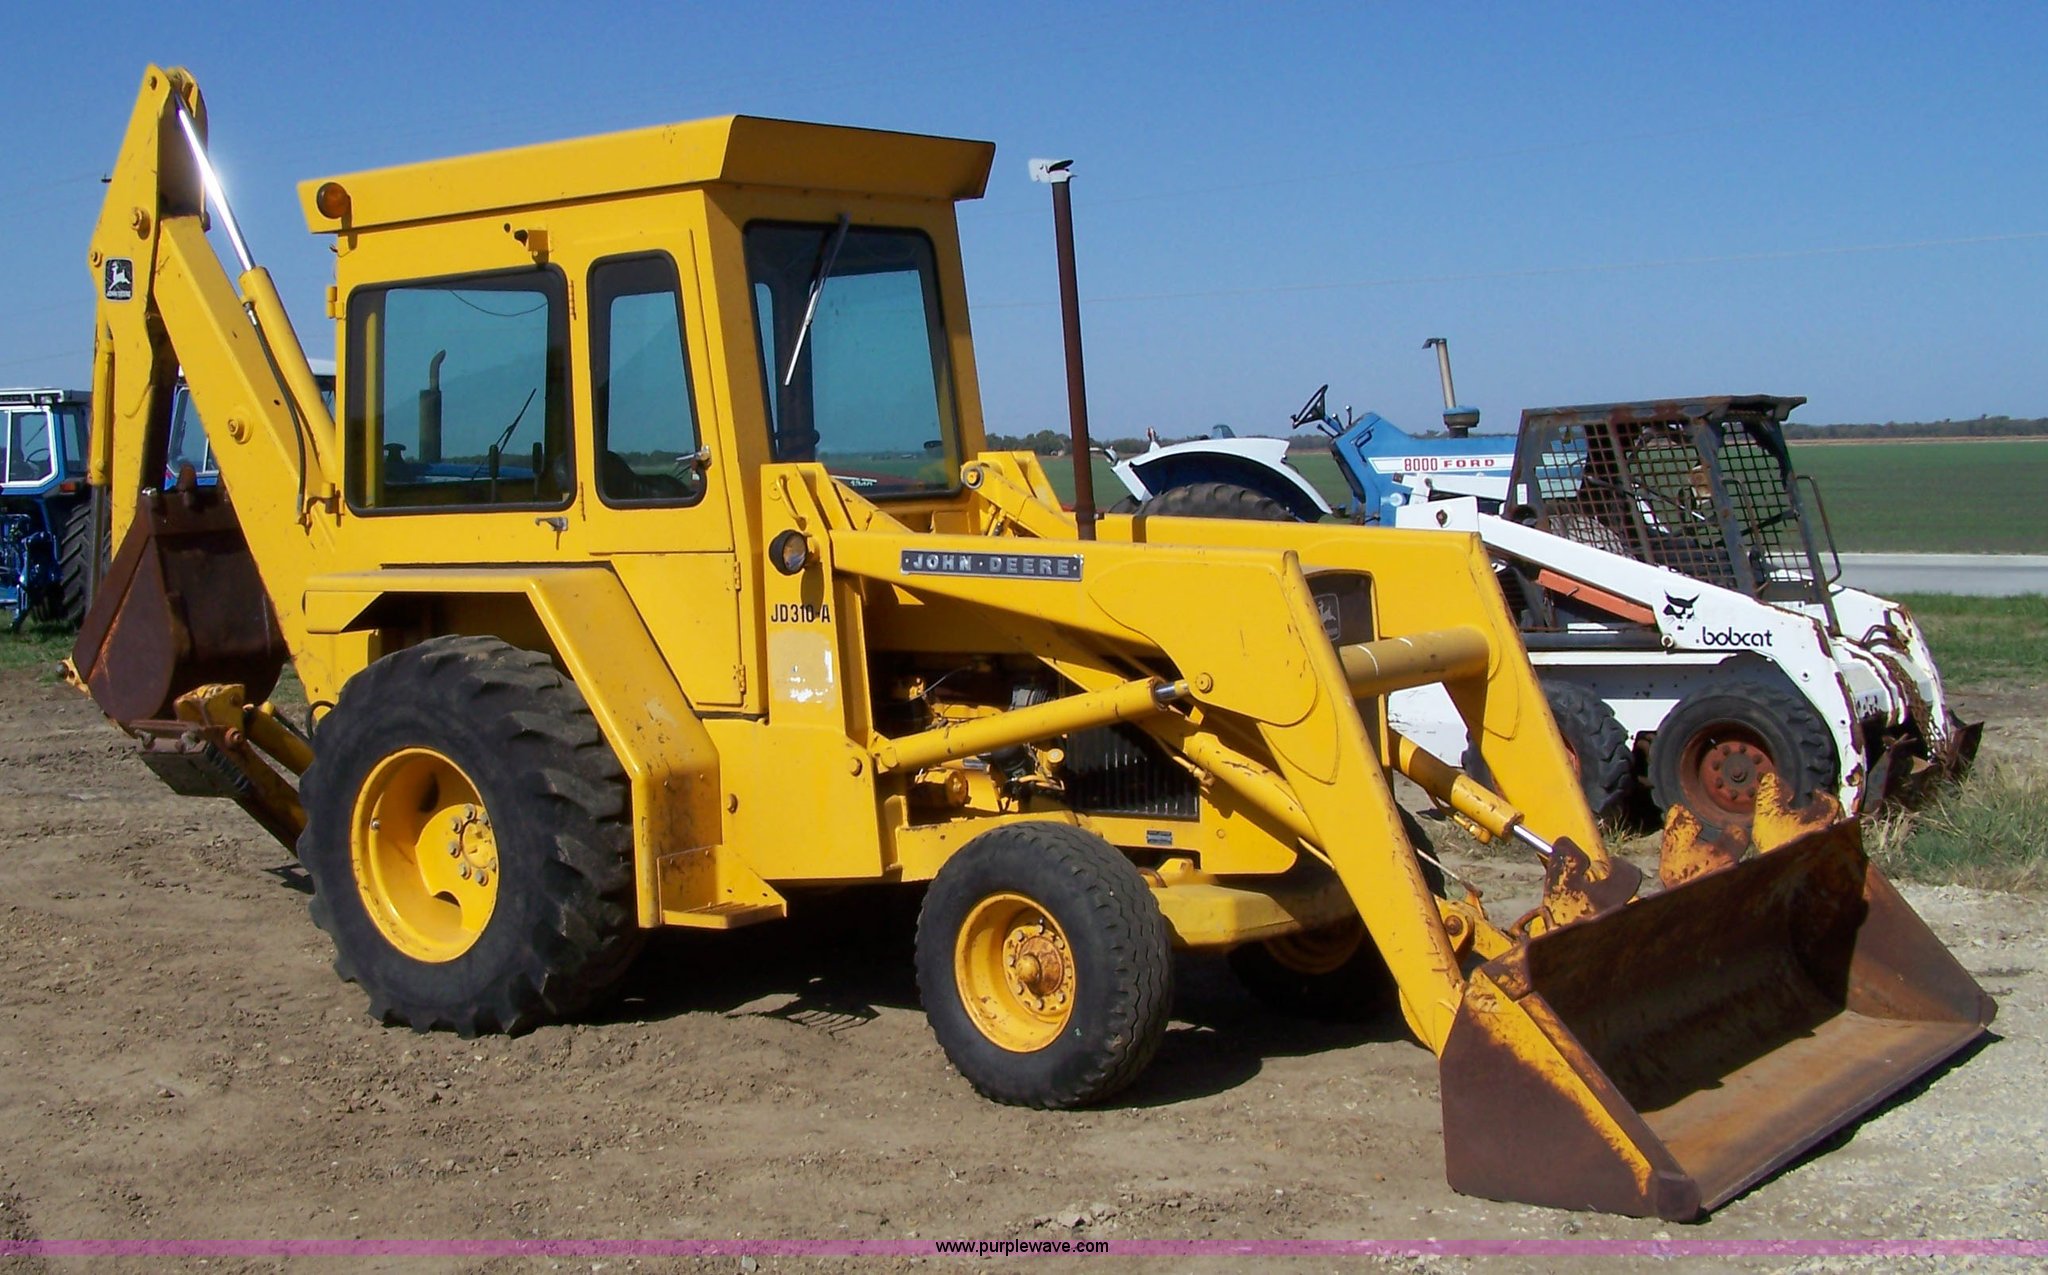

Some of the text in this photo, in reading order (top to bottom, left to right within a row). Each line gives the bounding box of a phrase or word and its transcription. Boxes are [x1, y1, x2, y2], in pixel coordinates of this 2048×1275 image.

[1404, 458, 1495, 471] 8000 FORD
[912, 554, 1069, 575] JOHN DEERE
[1702, 626, 1773, 647] bobcat
